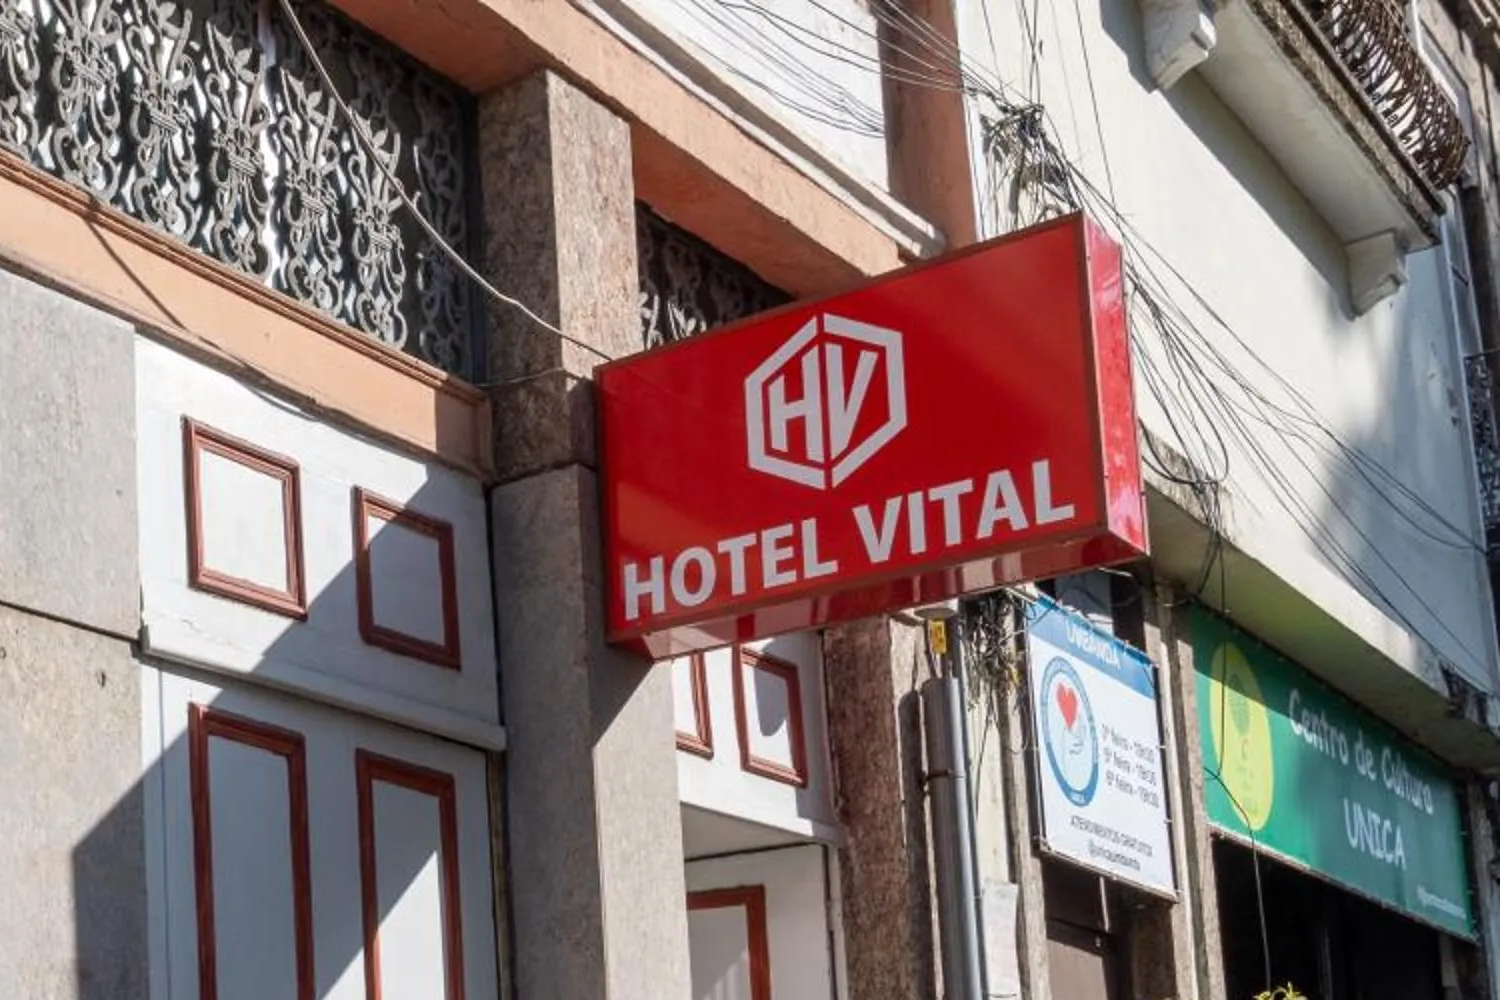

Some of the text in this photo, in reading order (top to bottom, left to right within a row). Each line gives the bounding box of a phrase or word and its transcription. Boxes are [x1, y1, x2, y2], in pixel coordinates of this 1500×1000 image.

[768, 342, 879, 463] HV
[622, 458, 1076, 621] HOTEL VITAL
[1288, 688, 1350, 767] Centro
[1354, 730, 1378, 781] de
[1343, 797, 1408, 871] UNICA
